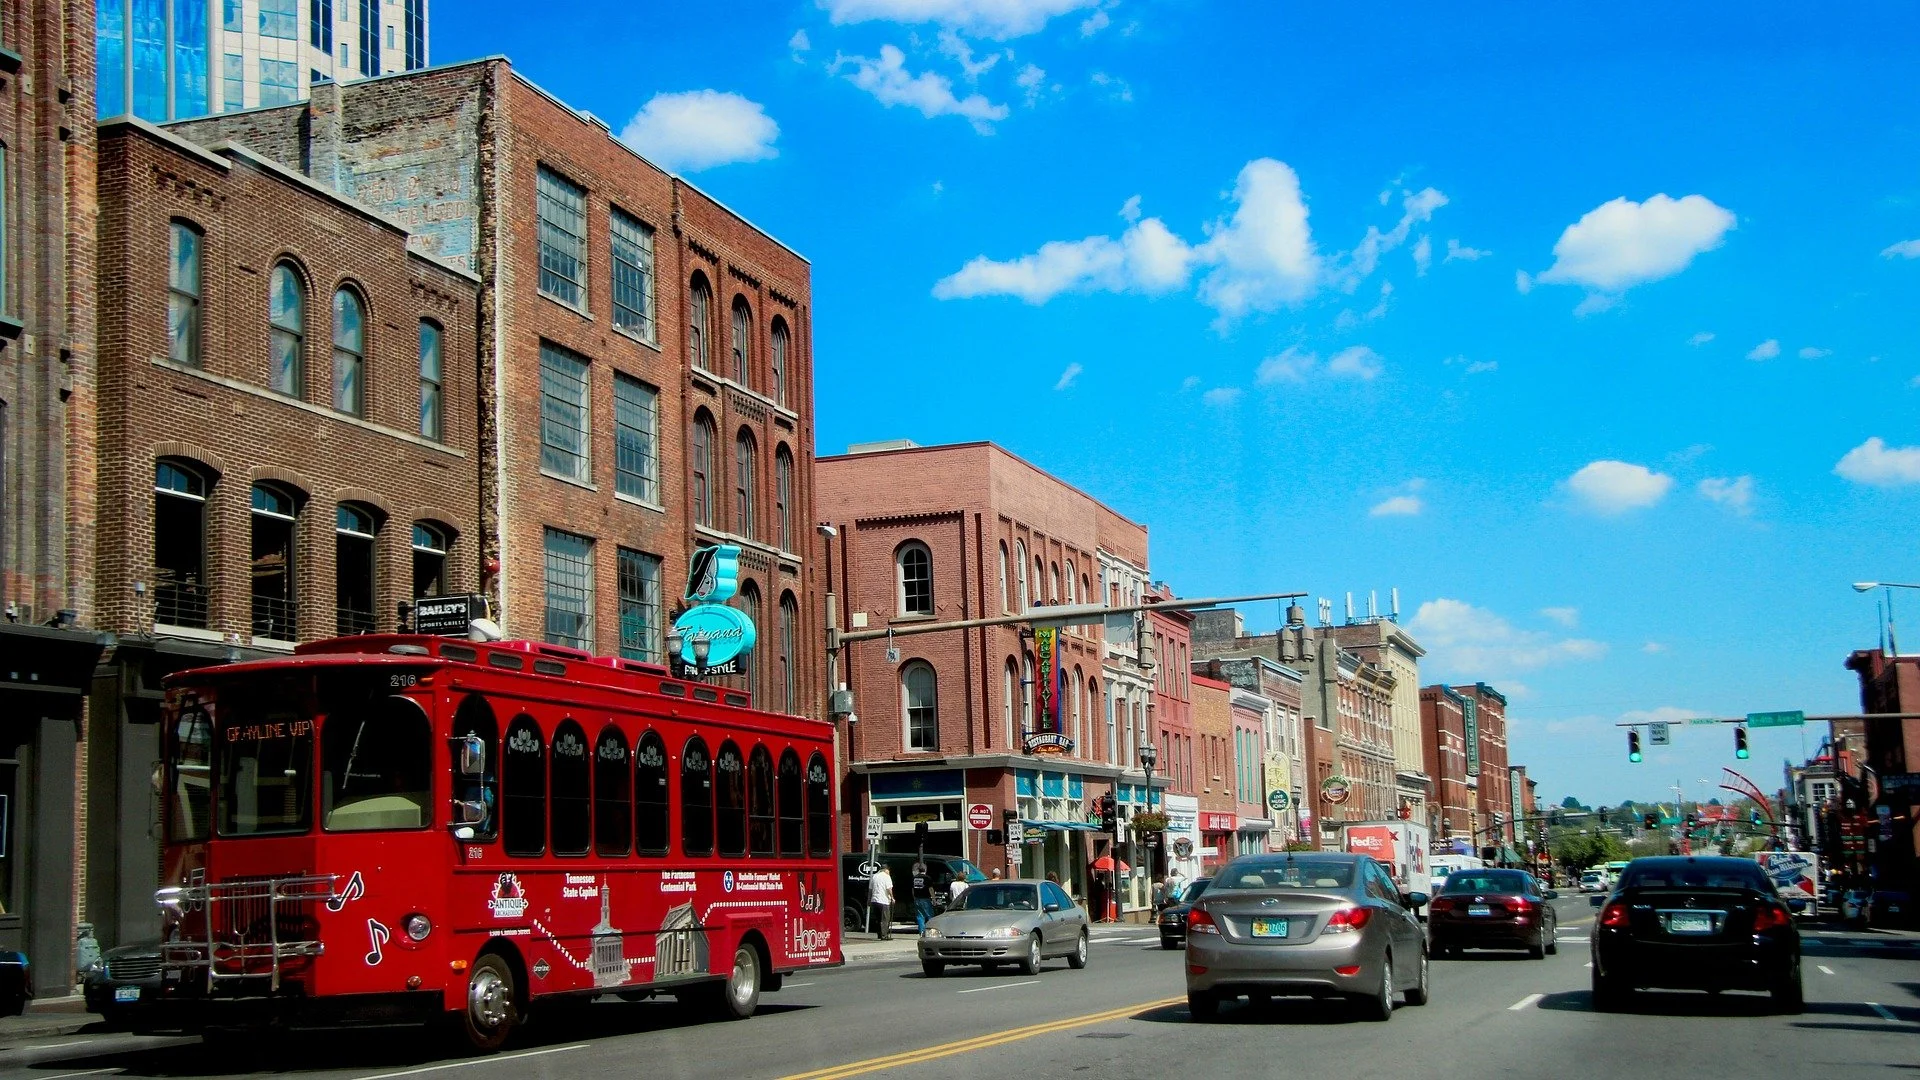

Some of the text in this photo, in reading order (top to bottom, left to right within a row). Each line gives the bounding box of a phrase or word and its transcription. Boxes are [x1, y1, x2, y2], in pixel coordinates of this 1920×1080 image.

[419, 603, 467, 616] BAILEY'S
[711, 660, 737, 675] STYLE
[390, 674, 417, 687] 216
[1351, 836, 1383, 847] FedEx
[565, 873, 595, 884] Tennessee
[563, 885, 598, 900] State Capitol
[661, 881, 697, 892] Centennial Park
[495, 898, 522, 909] ANTIQUE
